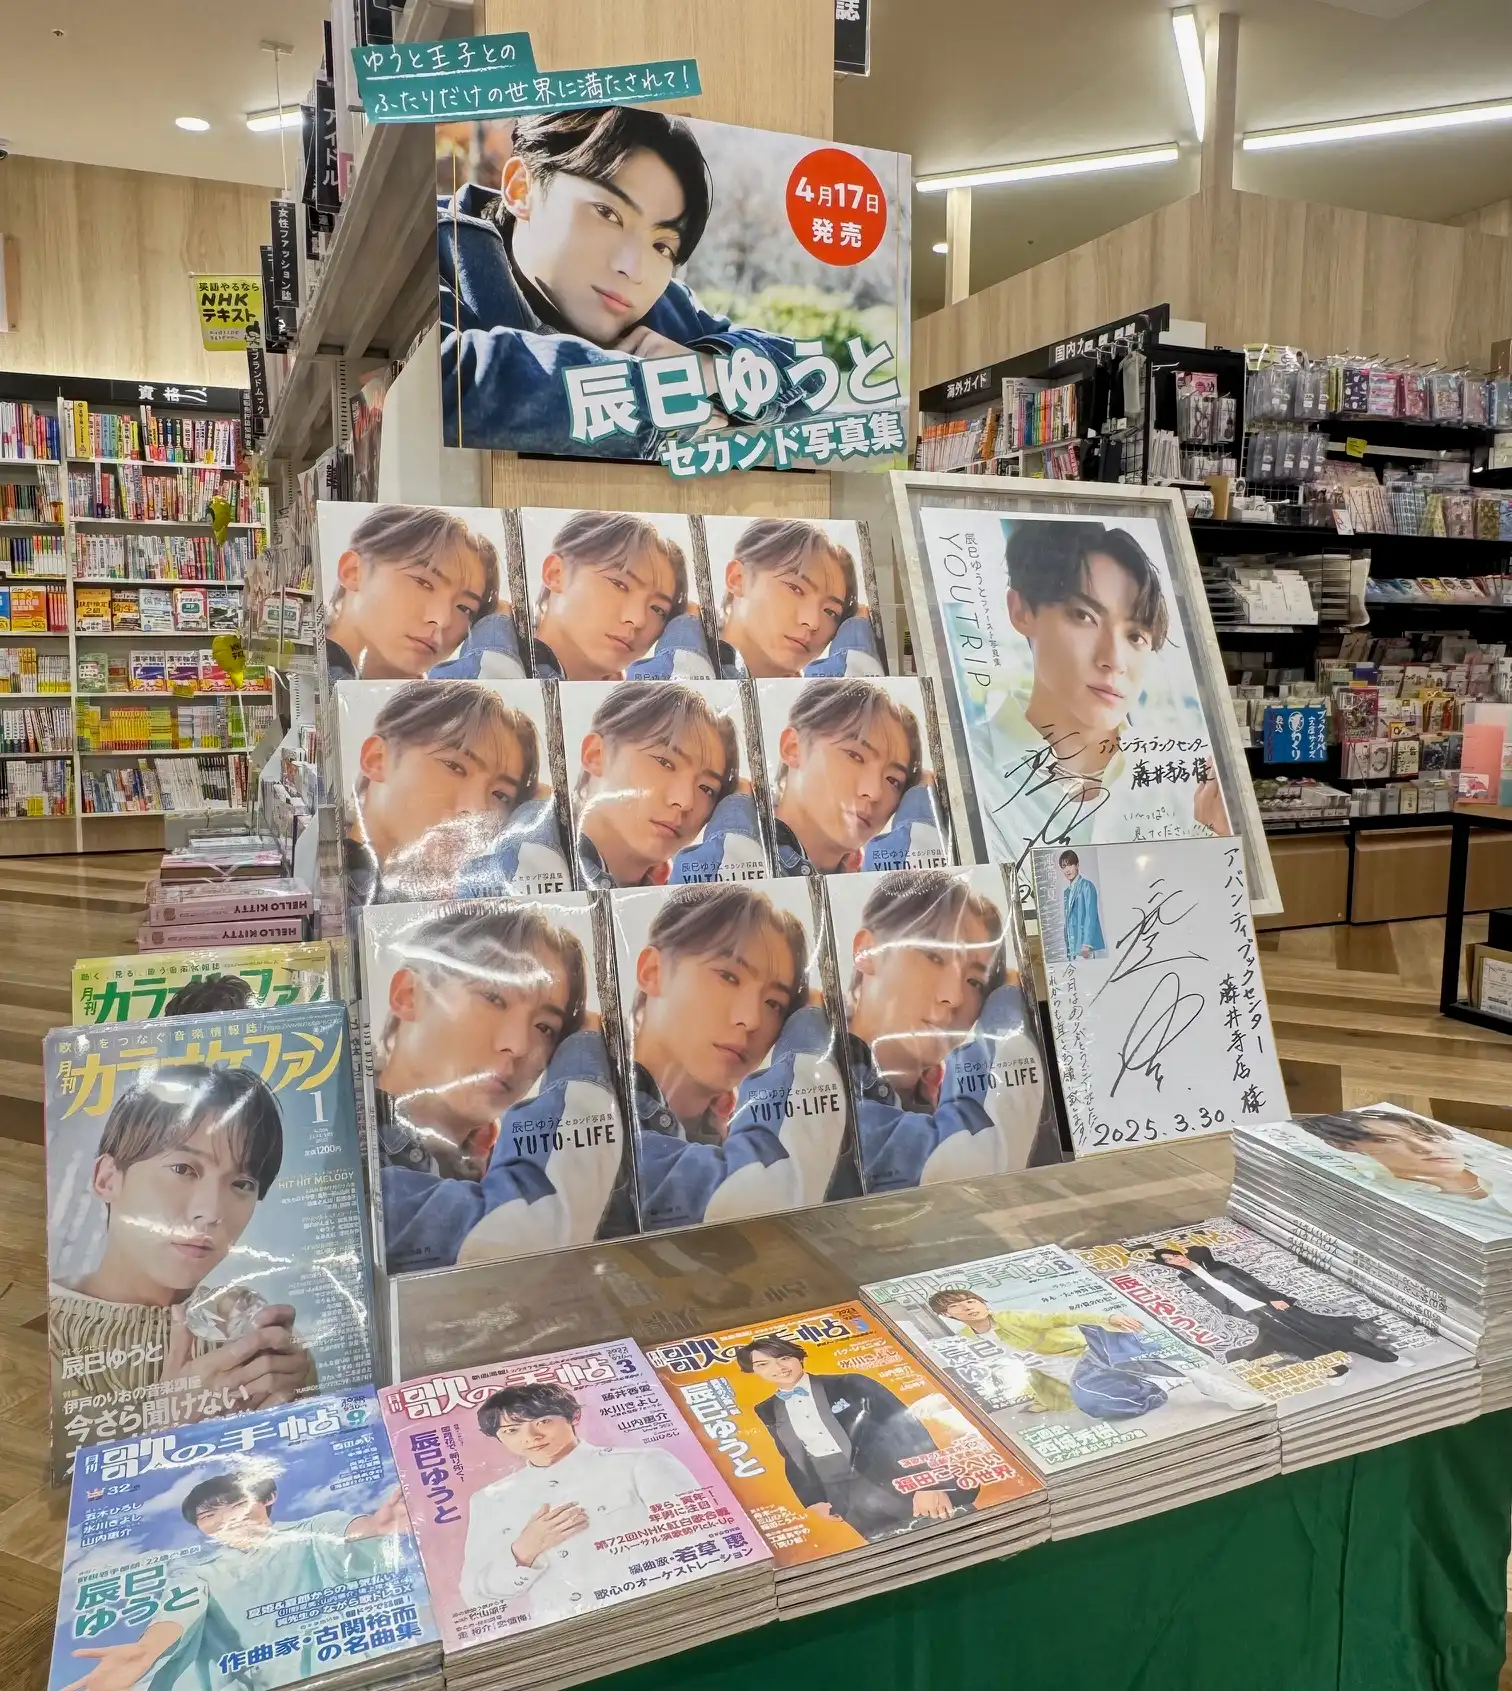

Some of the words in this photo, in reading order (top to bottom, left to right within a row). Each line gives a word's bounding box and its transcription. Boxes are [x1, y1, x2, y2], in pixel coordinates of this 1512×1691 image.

[363, 42, 515, 73] ゆうと王子との
[323, 108, 339, 186] アイドル
[794, 176, 879, 214] 4月17日
[811, 216, 863, 248] 発売
[201, 292, 249, 307] NHK
[202, 307, 257, 322] テキスト
[564, 336, 902, 442] 辰巳ゆうと
[946, 371, 988, 399] 海外ガイド
[662, 412, 903, 476] セカンド写真集
[233, 903, 268, 914] KITTY
[270, 900, 308, 912] HELLO
[222, 930, 258, 939] KITTY
[259, 927, 297, 938] HELLO
[1223, 847, 1264, 1054] アバンティブックセンター
[81, 987, 97, 1016] 月刊
[58, 1024, 258, 1054] 歌をつなぐ音楽情報誌
[57, 1060, 77, 1096] 月刊
[956, 1066, 1038, 1094] YUTOLIFE
[308, 1090, 329, 1124] 1
[278, 1180, 296, 1190] HIT
[314, 1171, 355, 1187] MELODY
[1053, 1260, 1074, 1271] 8
[1108, 1273, 1221, 1346] 辰巳ゆうと
[61, 1341, 163, 1380] 辰巳ゆうと
[616, 1359, 637, 1374] 3
[938, 1340, 1005, 1368] 辰巳
[402, 1357, 616, 1420] 歌の手帖
[64, 1384, 249, 1443] 今さら聞けない
[346, 1409, 366, 1425] 9
[600, 1397, 659, 1416] 氷川きよし
[679, 1379, 767, 1478] 辰巳ゆうと
[101, 1408, 342, 1482] 歌の手帖
[85, 1453, 99, 1475] 月刊
[409, 1428, 462, 1525] 辰巳ゆうと
[892, 1453, 1004, 1495] 福田こうへい
[955, 1463, 1017, 1491] の世界
[82, 1513, 142, 1534] 氷川きよし
[84, 1502, 142, 1522] 五木ひろし
[593, 1506, 731, 1551] 第72回NHK紅白歌合戦
[75, 1564, 167, 1611] 辰巳
[593, 1548, 754, 1600] 歌心のオーケストレーション
[72, 1586, 201, 1638] ゆうと
[218, 1604, 417, 1674] 作曲家・古関裕而
[316, 1620, 423, 1663] の名曲集
